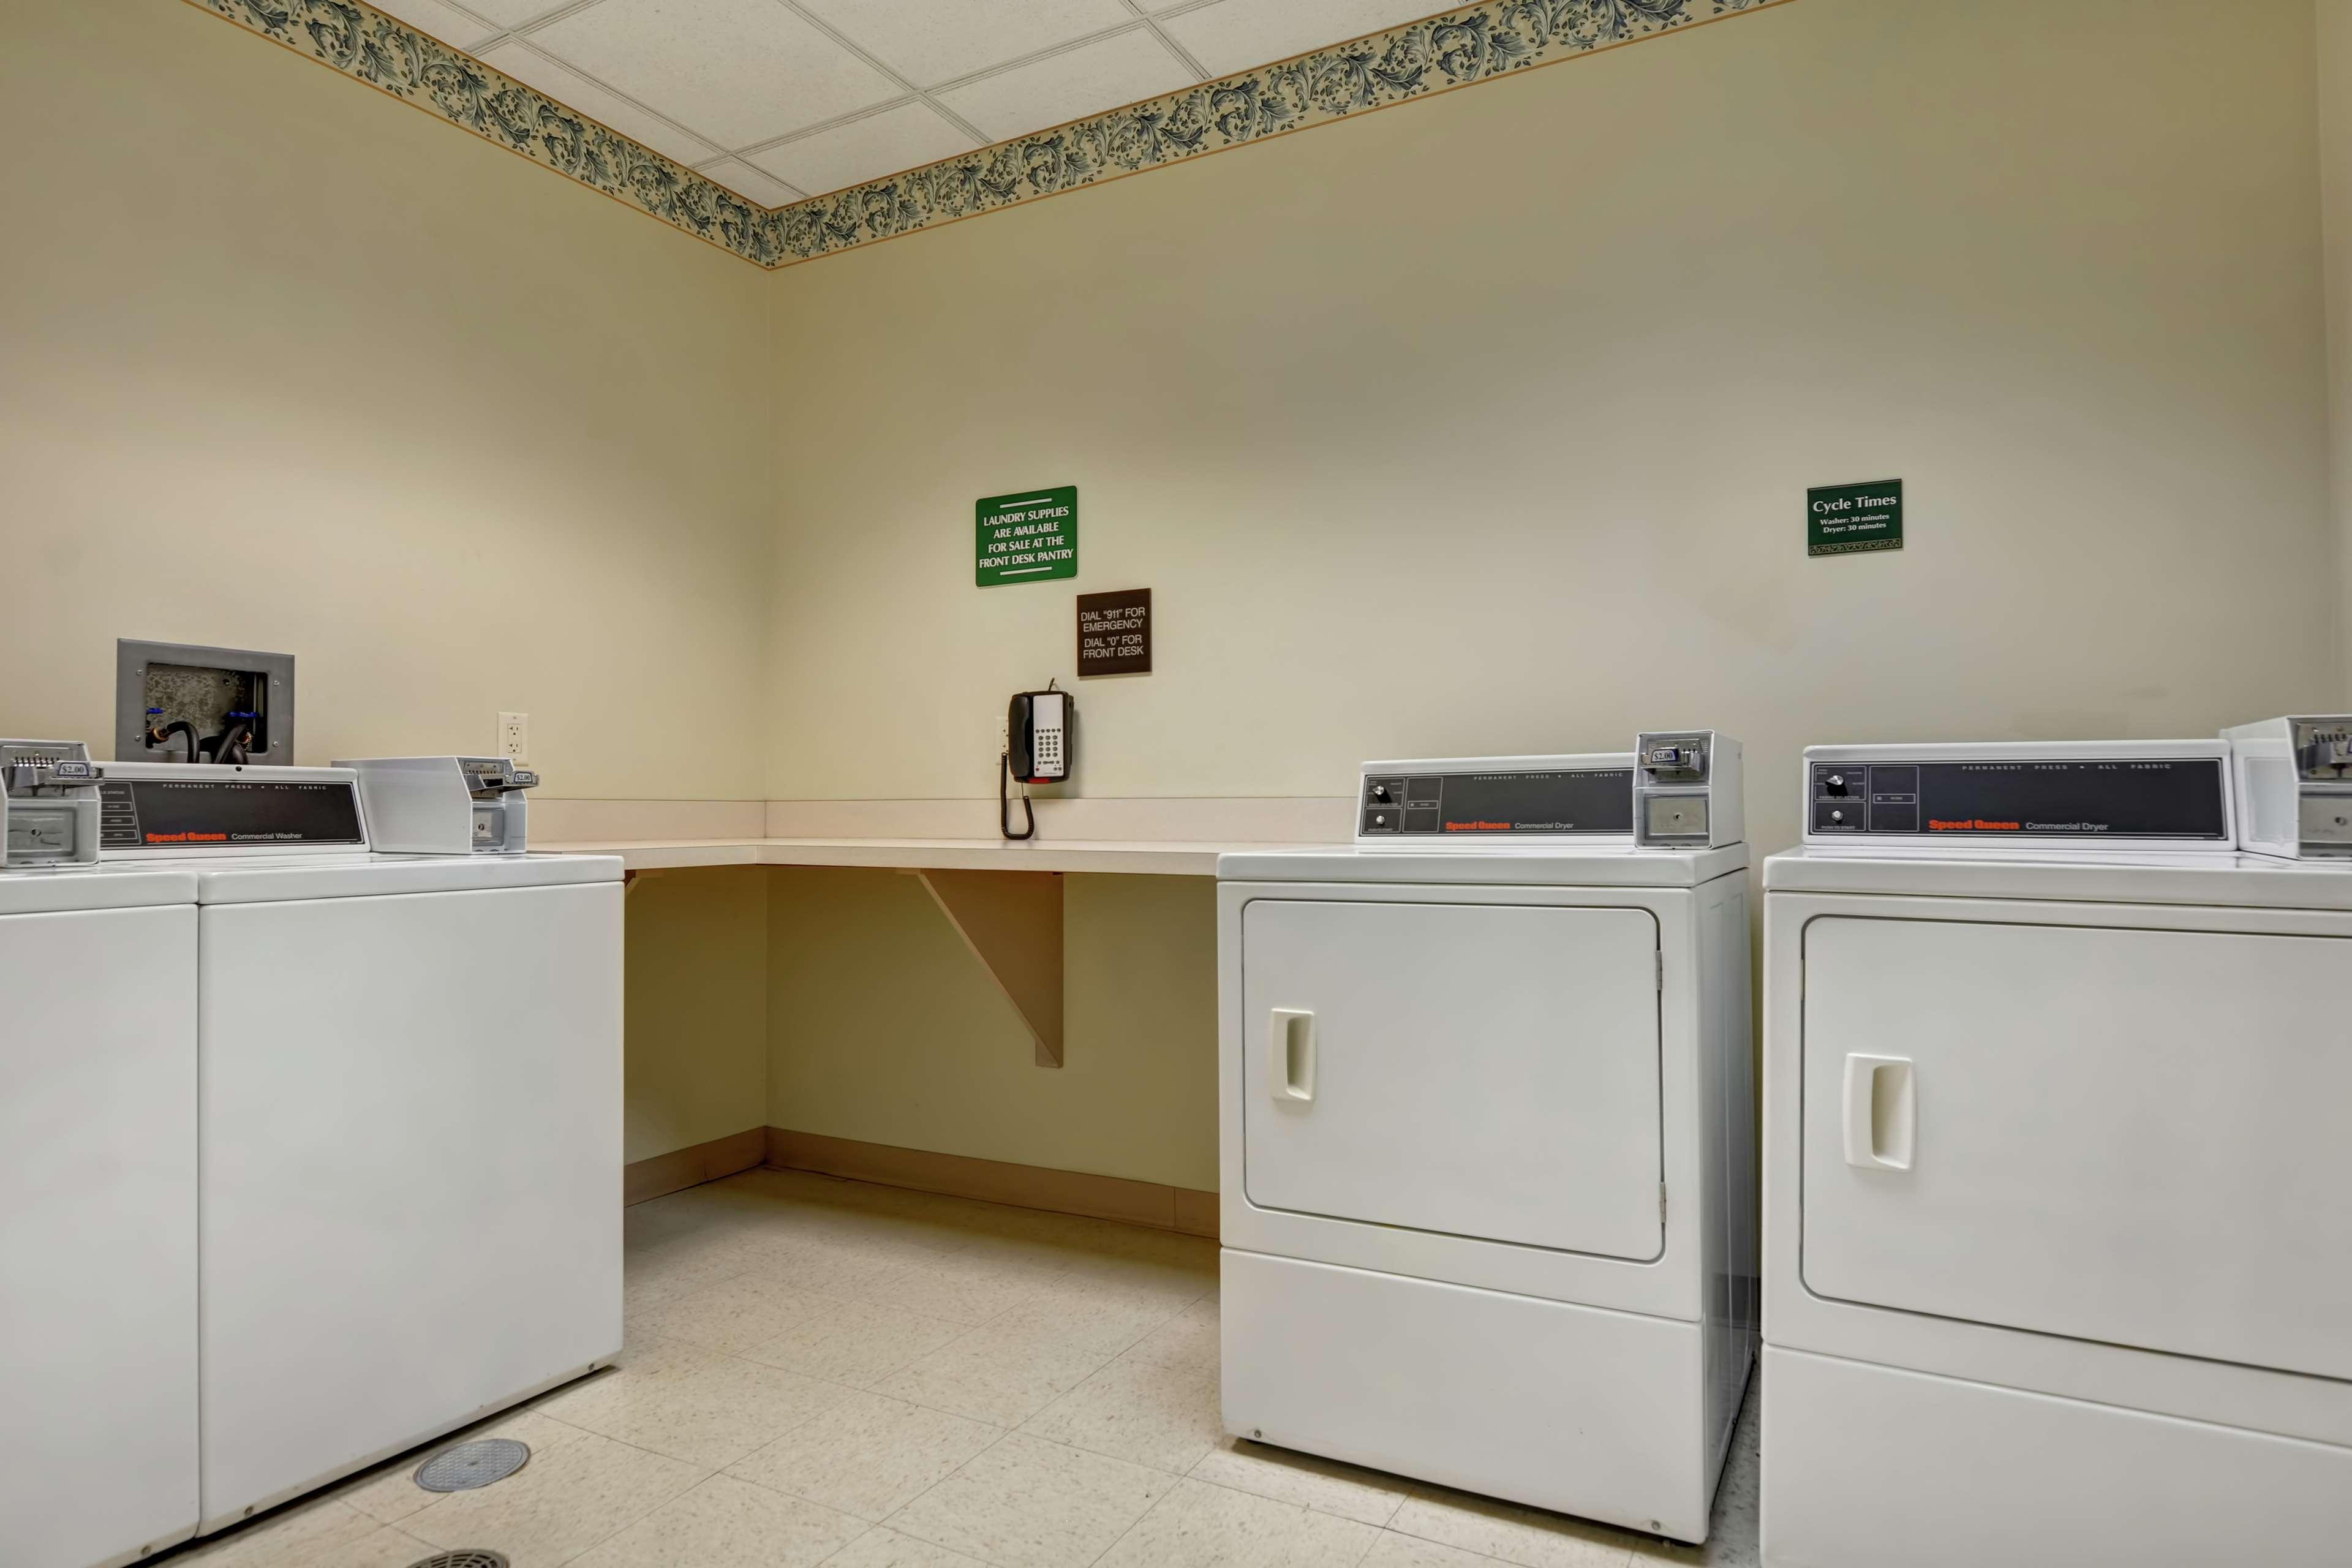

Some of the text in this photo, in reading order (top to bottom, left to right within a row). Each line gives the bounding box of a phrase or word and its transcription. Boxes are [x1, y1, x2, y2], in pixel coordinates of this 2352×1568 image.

[1812, 496, 1897, 514] Cycle Times
[983, 506, 1069, 526] LAUNDRY SUPPLIES
[993, 522, 1059, 539] ARE AVAILABLE
[1823, 526, 1846, 534] Dryer:
[988, 535, 1065, 554] FOR SALE AT THE
[979, 548, 1073, 568] FRONT DESK PANTRY
[1080, 611, 1102, 621] DIAL
[1125, 606, 1145, 617] FOR
[1083, 618, 1143, 632] EMERGENCY
[1084, 638, 1105, 647] DIAL
[1122, 634, 1142, 644] FOR
[1083, 646, 1144, 658] FRONT DESK
[1654, 752, 1673, 761] $2.00
[1446, 821, 1477, 831] Speed
[1478, 821, 1510, 829] Queen
[1929, 820, 1972, 831] Speed
[1973, 820, 2019, 829] Queen
[146, 833, 186, 843] Speed
[187, 832, 227, 842] Queen
